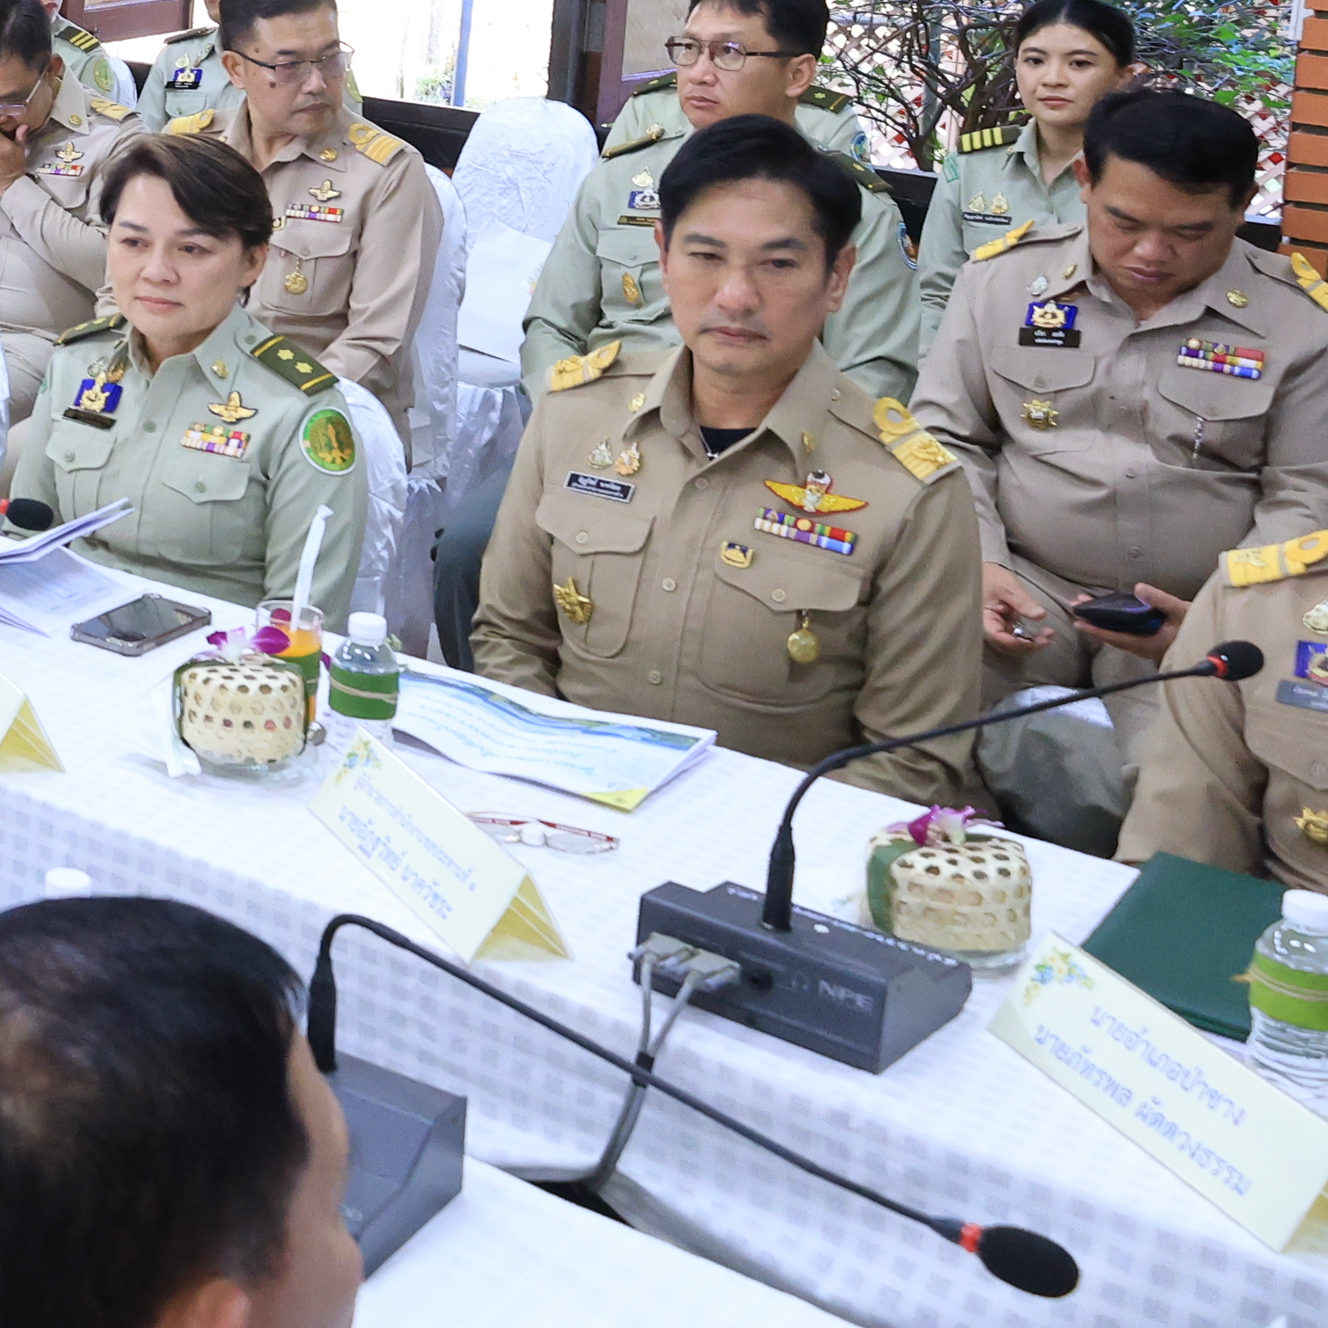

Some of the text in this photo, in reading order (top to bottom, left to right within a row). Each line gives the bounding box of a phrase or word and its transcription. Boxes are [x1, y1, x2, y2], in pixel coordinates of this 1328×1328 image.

[1090, 1005, 1248, 1127] นายอำเภอป่าซาง
